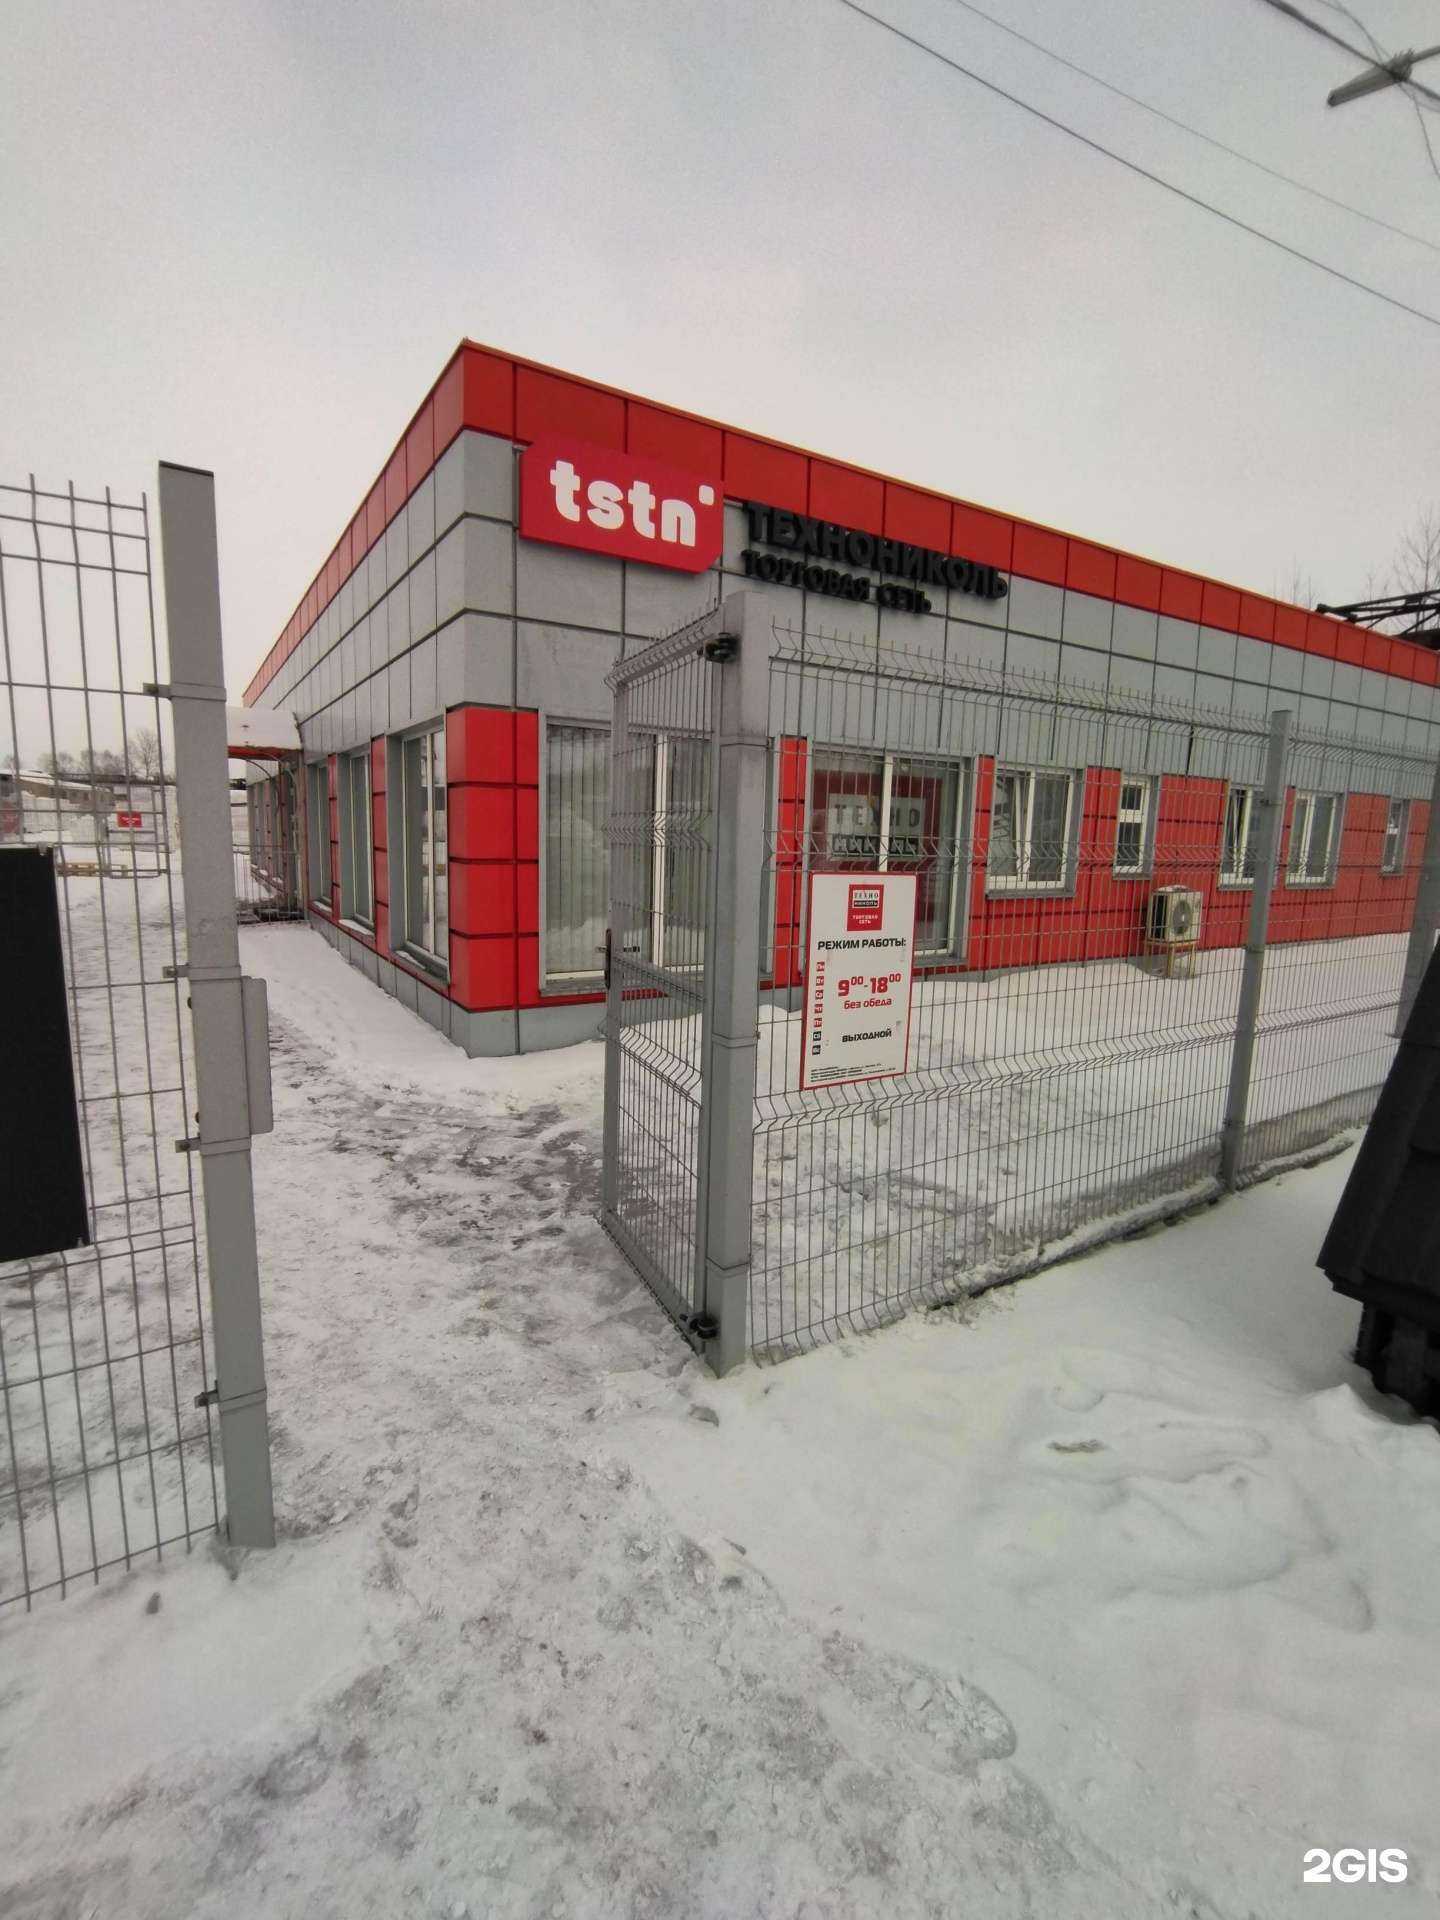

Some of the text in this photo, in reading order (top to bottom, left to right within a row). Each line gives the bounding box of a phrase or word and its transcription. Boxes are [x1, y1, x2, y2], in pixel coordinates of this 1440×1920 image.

[743, 501, 1008, 599] ТЕХНОНИКОЛЬ
[741, 549, 933, 614] ТОРГОВАЯ СЕТЬ
[817, 937, 907, 950] РЕЖИМ РАБОТЫ:
[844, 998, 893, 1009] без обеда
